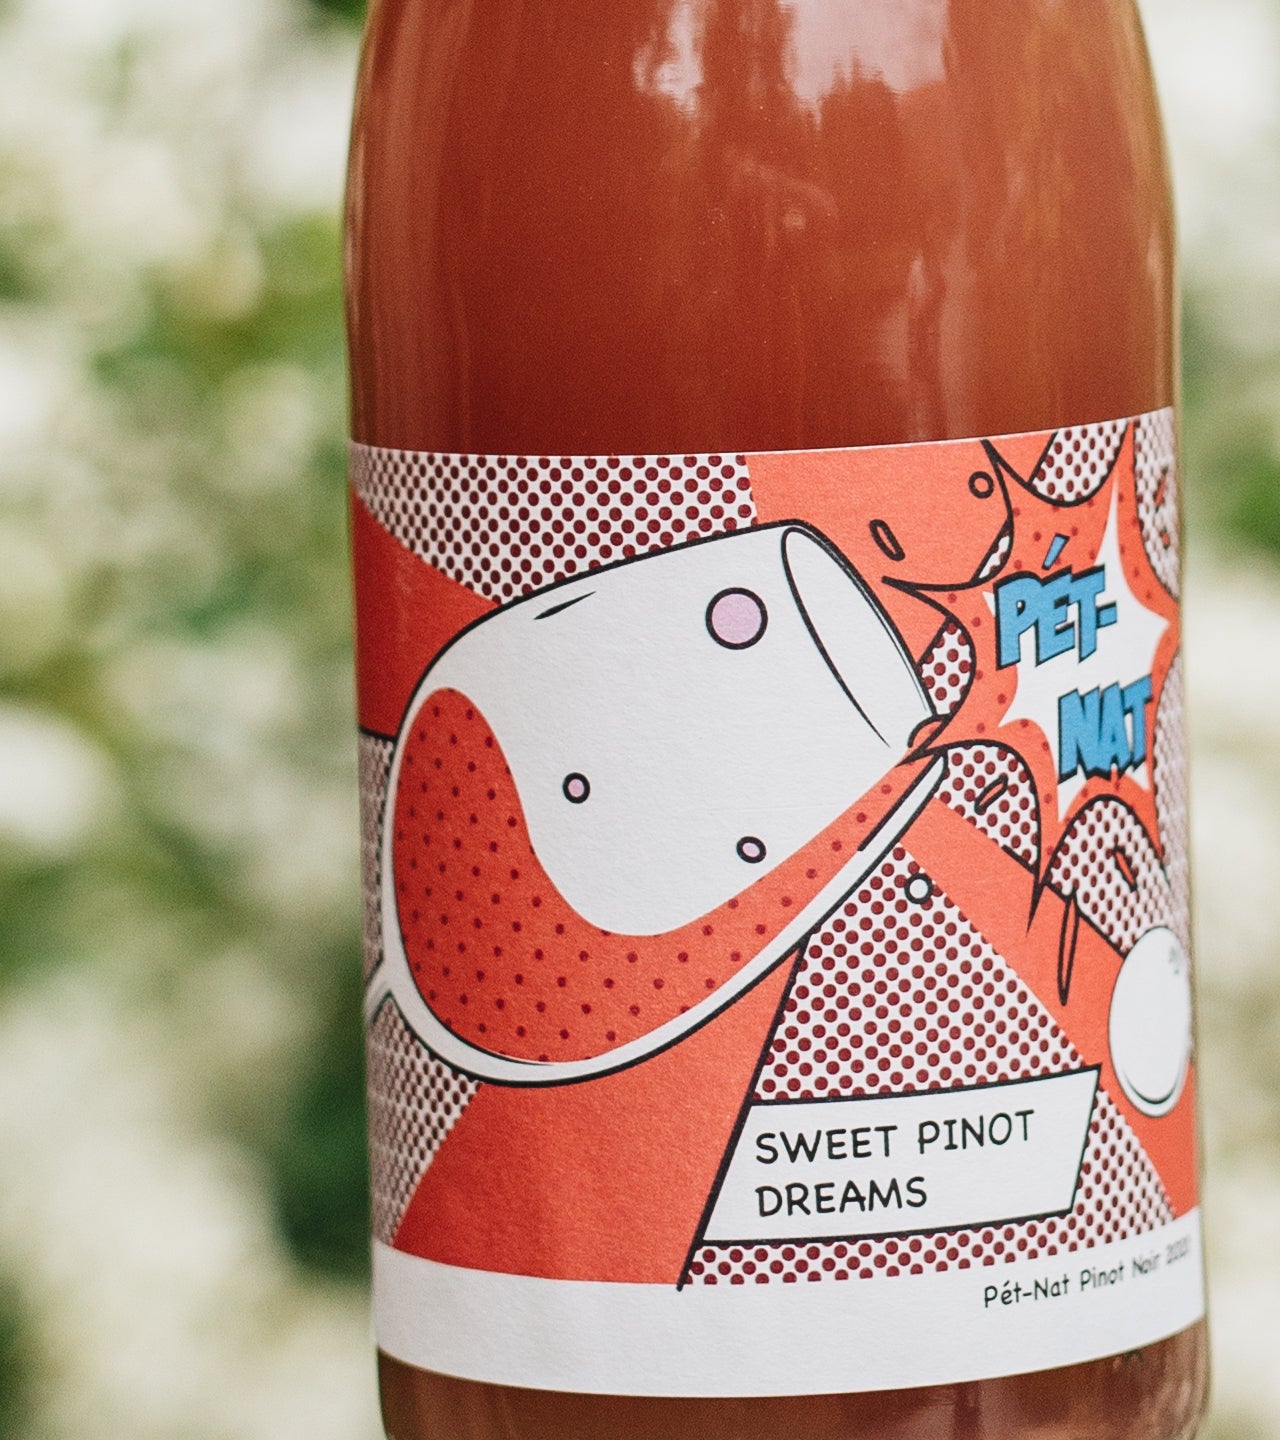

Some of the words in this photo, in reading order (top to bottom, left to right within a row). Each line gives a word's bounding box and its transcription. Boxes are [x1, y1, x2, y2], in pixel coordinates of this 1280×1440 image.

[993, 533, 1118, 671] PÉT-
[1058, 674, 1153, 784] NAT
[755, 1125, 898, 1165] SWEET
[918, 1109, 1035, 1155] PINOT
[754, 1176, 928, 1218] DREAMS
[983, 1272, 1070, 1308] Pét-Nat
[1080, 1260, 1124, 1292] Pinot
[1131, 1250, 1160, 1279] Noir
